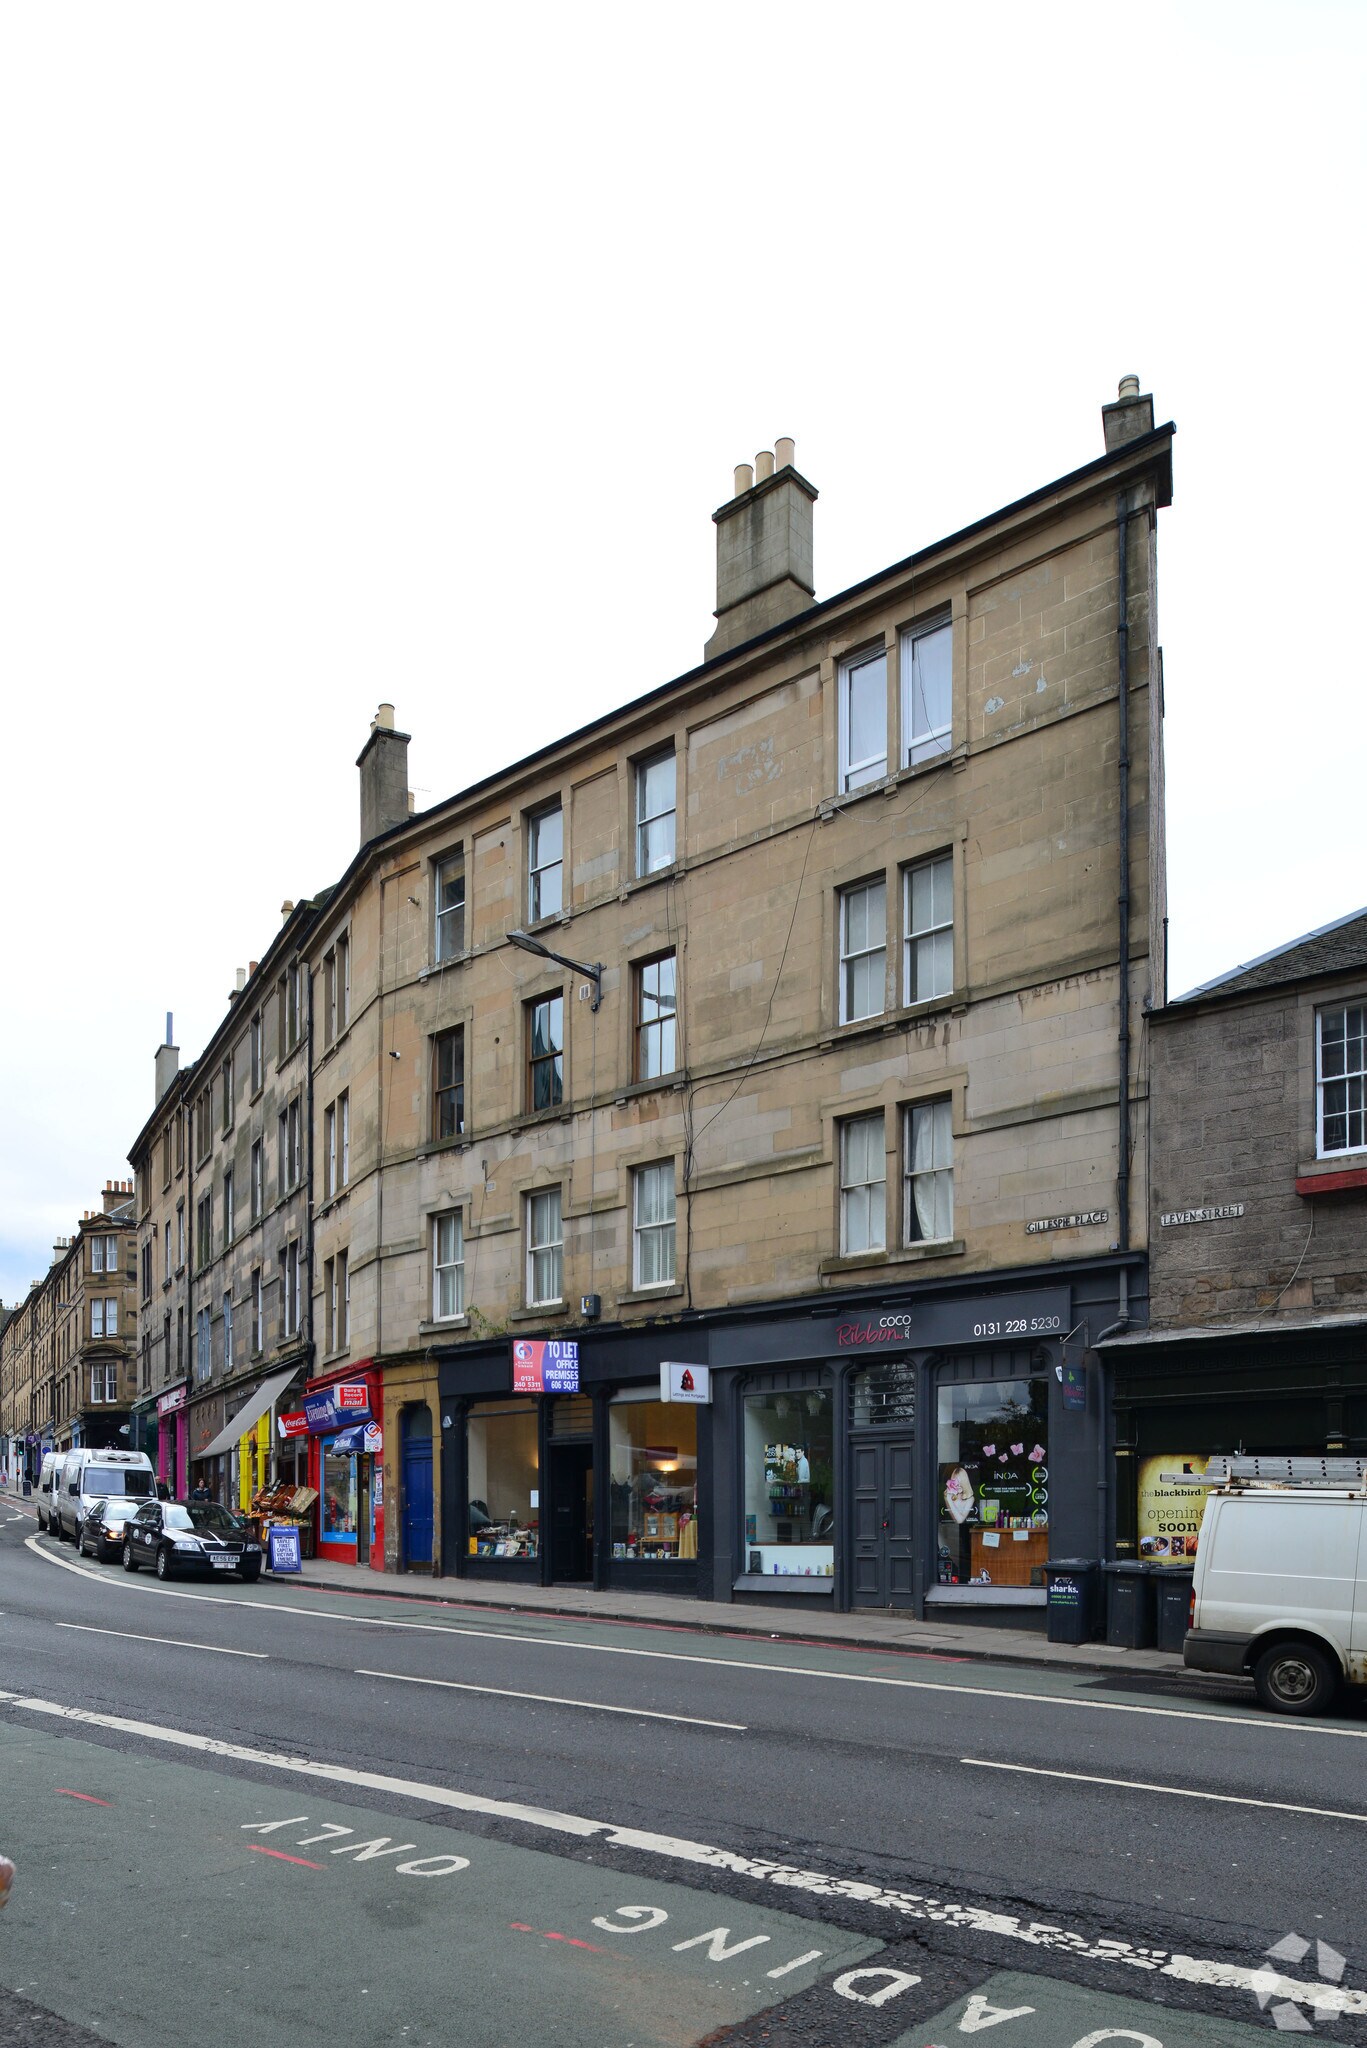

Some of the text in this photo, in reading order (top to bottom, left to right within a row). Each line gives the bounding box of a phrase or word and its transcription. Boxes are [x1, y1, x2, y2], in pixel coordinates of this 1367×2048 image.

[1028, 1212, 1107, 1232] GILLESPIE PLACE
[1164, 1205, 1241, 1224] LEVEN STREET
[836, 1322, 904, 1346] Ribbon
[973, 1315, 1060, 1336] 0131 228 5230
[547, 1341, 578, 1358] TO LET
[556, 1360, 578, 1369] OFFICE
[545, 1370, 579, 1380] PREMISES
[551, 1380, 562, 1389] 606
[343, 1397, 363, 1406] mail
[1158, 1522, 1198, 1532] soon
[240, 1816, 471, 1876] ONLY
